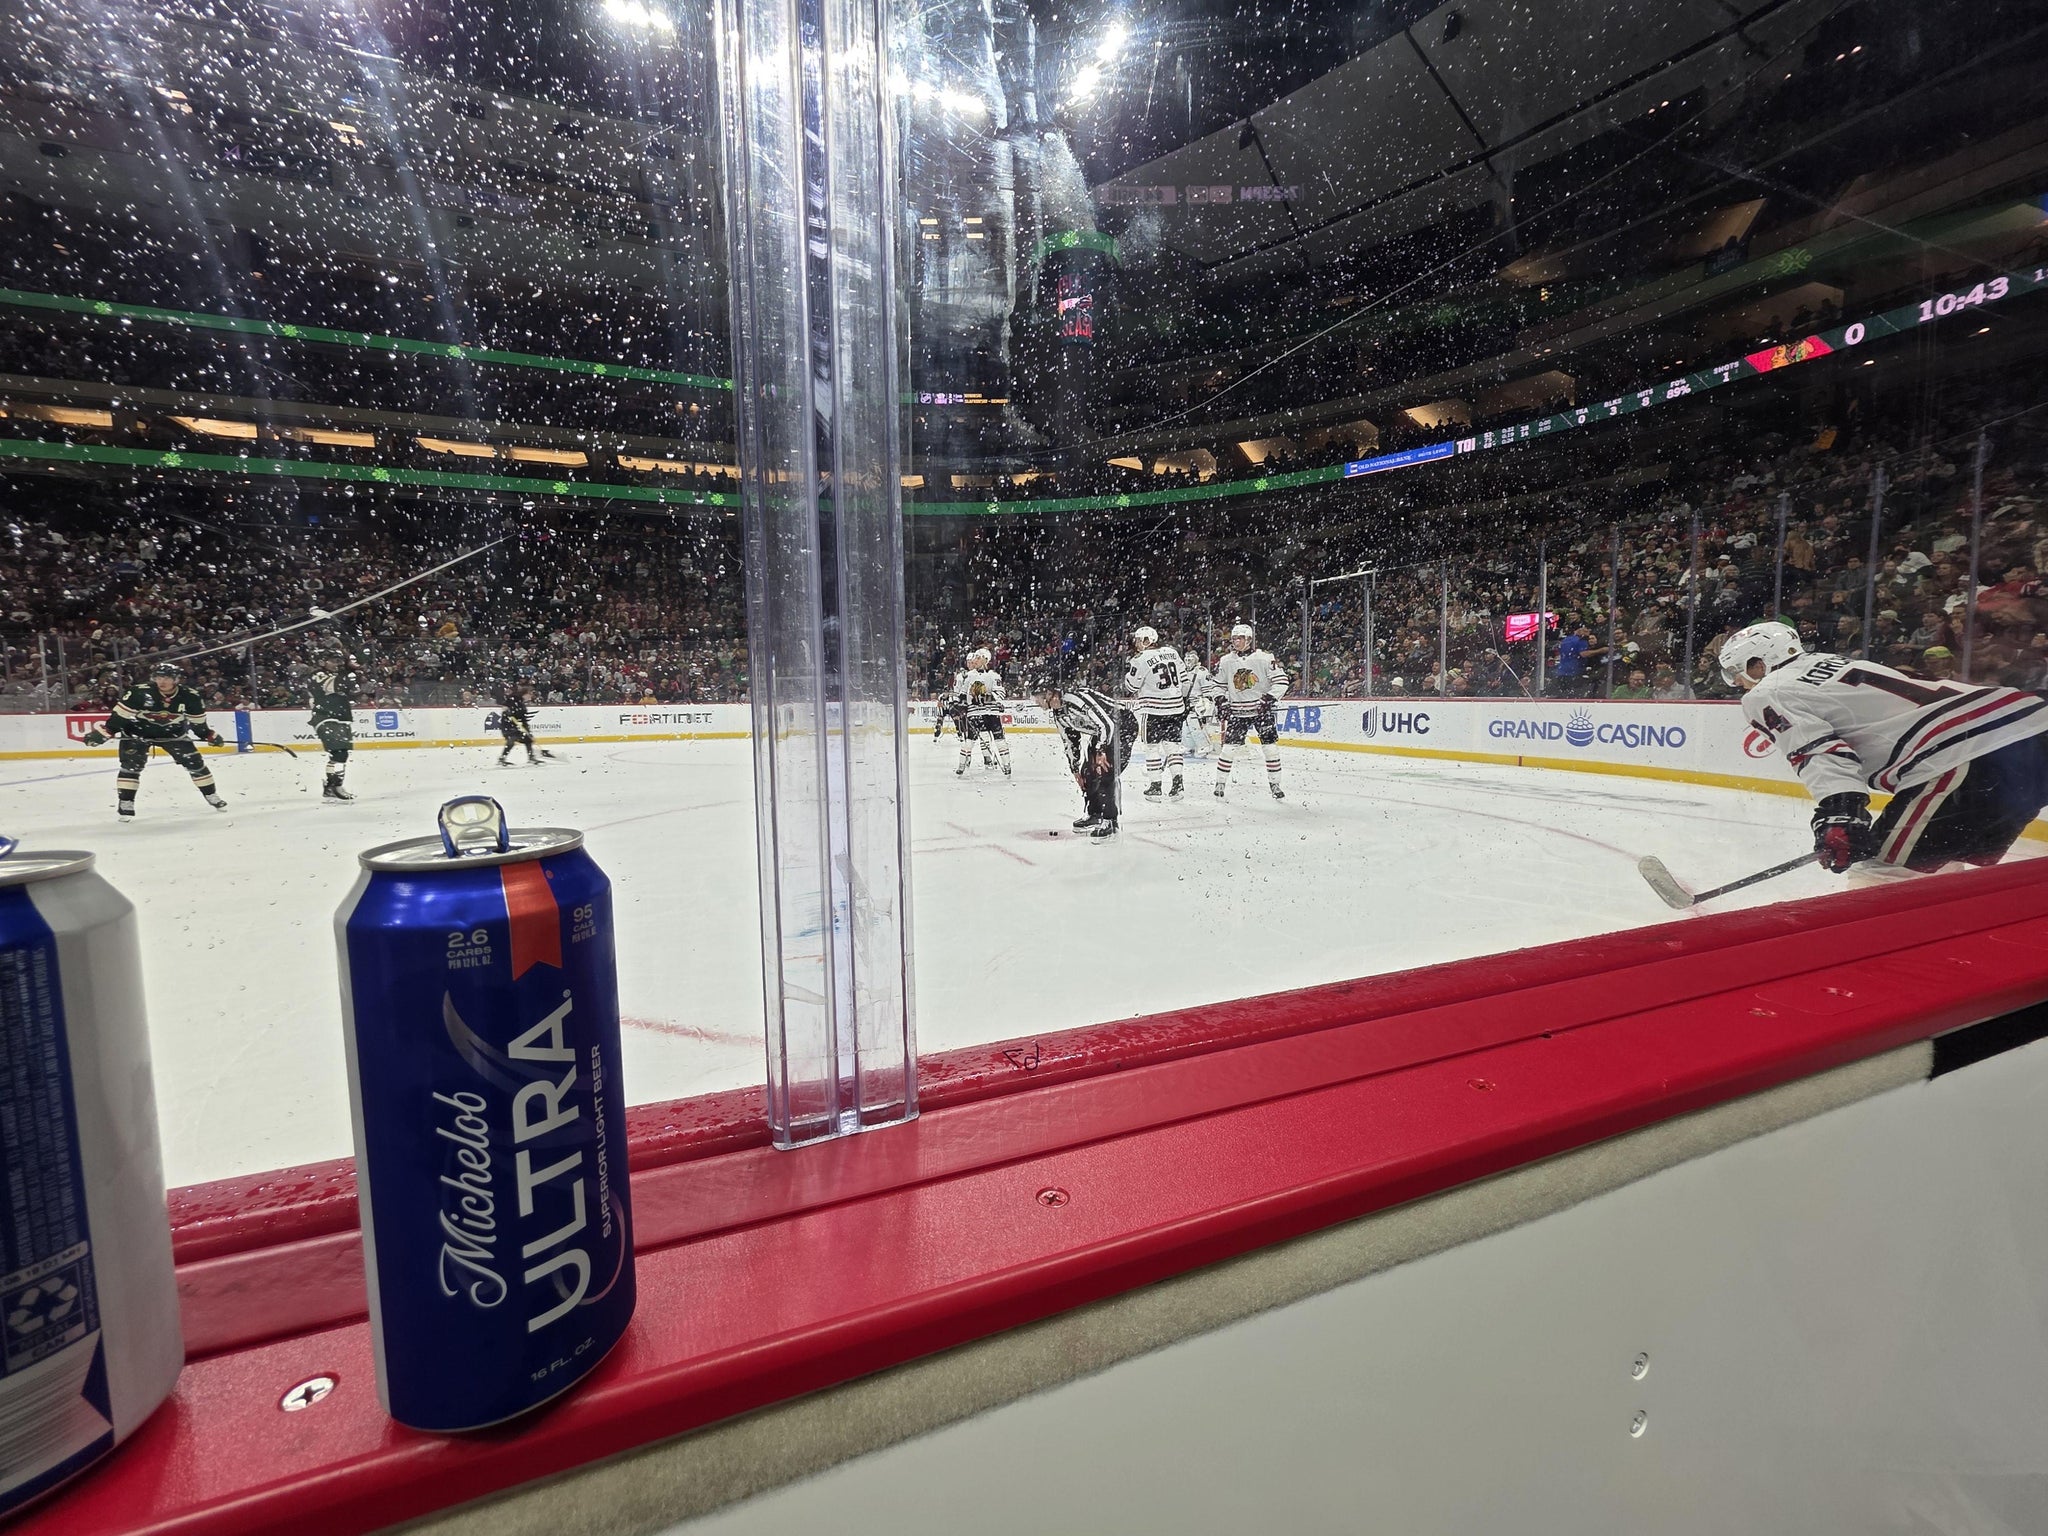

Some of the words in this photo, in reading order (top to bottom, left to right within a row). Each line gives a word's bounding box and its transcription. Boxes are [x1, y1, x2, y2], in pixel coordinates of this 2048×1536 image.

[1918, 276, 2010, 323] 10:43
[1844, 322, 1865, 346] 0
[1713, 361, 1740, 375] SHOTS
[1722, 372, 1730, 383] 1
[1637, 388, 1654, 399] HITS
[1666, 385, 1691, 400] 89%
[1603, 398, 1622, 408] BLKS
[1609, 405, 1618, 416] 3
[1641, 397, 1650, 407] 8
[1577, 414, 1586, 424] 0
[1456, 437, 1476, 454] TOI
[1147, 657, 1159, 668] DEL
[1796, 654, 1851, 686] KORC
[1152, 661, 1179, 690] 38
[178, 703, 187, 713] A
[1382, 711, 1430, 735] UHC
[1489, 718, 1564, 742] GRAND
[1597, 722, 1687, 750] CASINO
[573, 903, 593, 922] 95
[573, 919, 594, 933] CALS
[448, 928, 489, 948] 2.6
[446, 946, 492, 959] CARBS
[449, 959, 462, 970] PER
[591, 1043, 603, 1094] BEER
[594, 1096, 606, 1149] LIGHT
[507, 996, 591, 1334] ULTRA
[432, 1091, 508, 1308] Michelob
[598, 1149, 612, 1239] SUPERIOR
[531, 1366, 548, 1383] 16
[550, 1355, 572, 1374] FL.
[574, 1337, 596, 1357] OZ.
